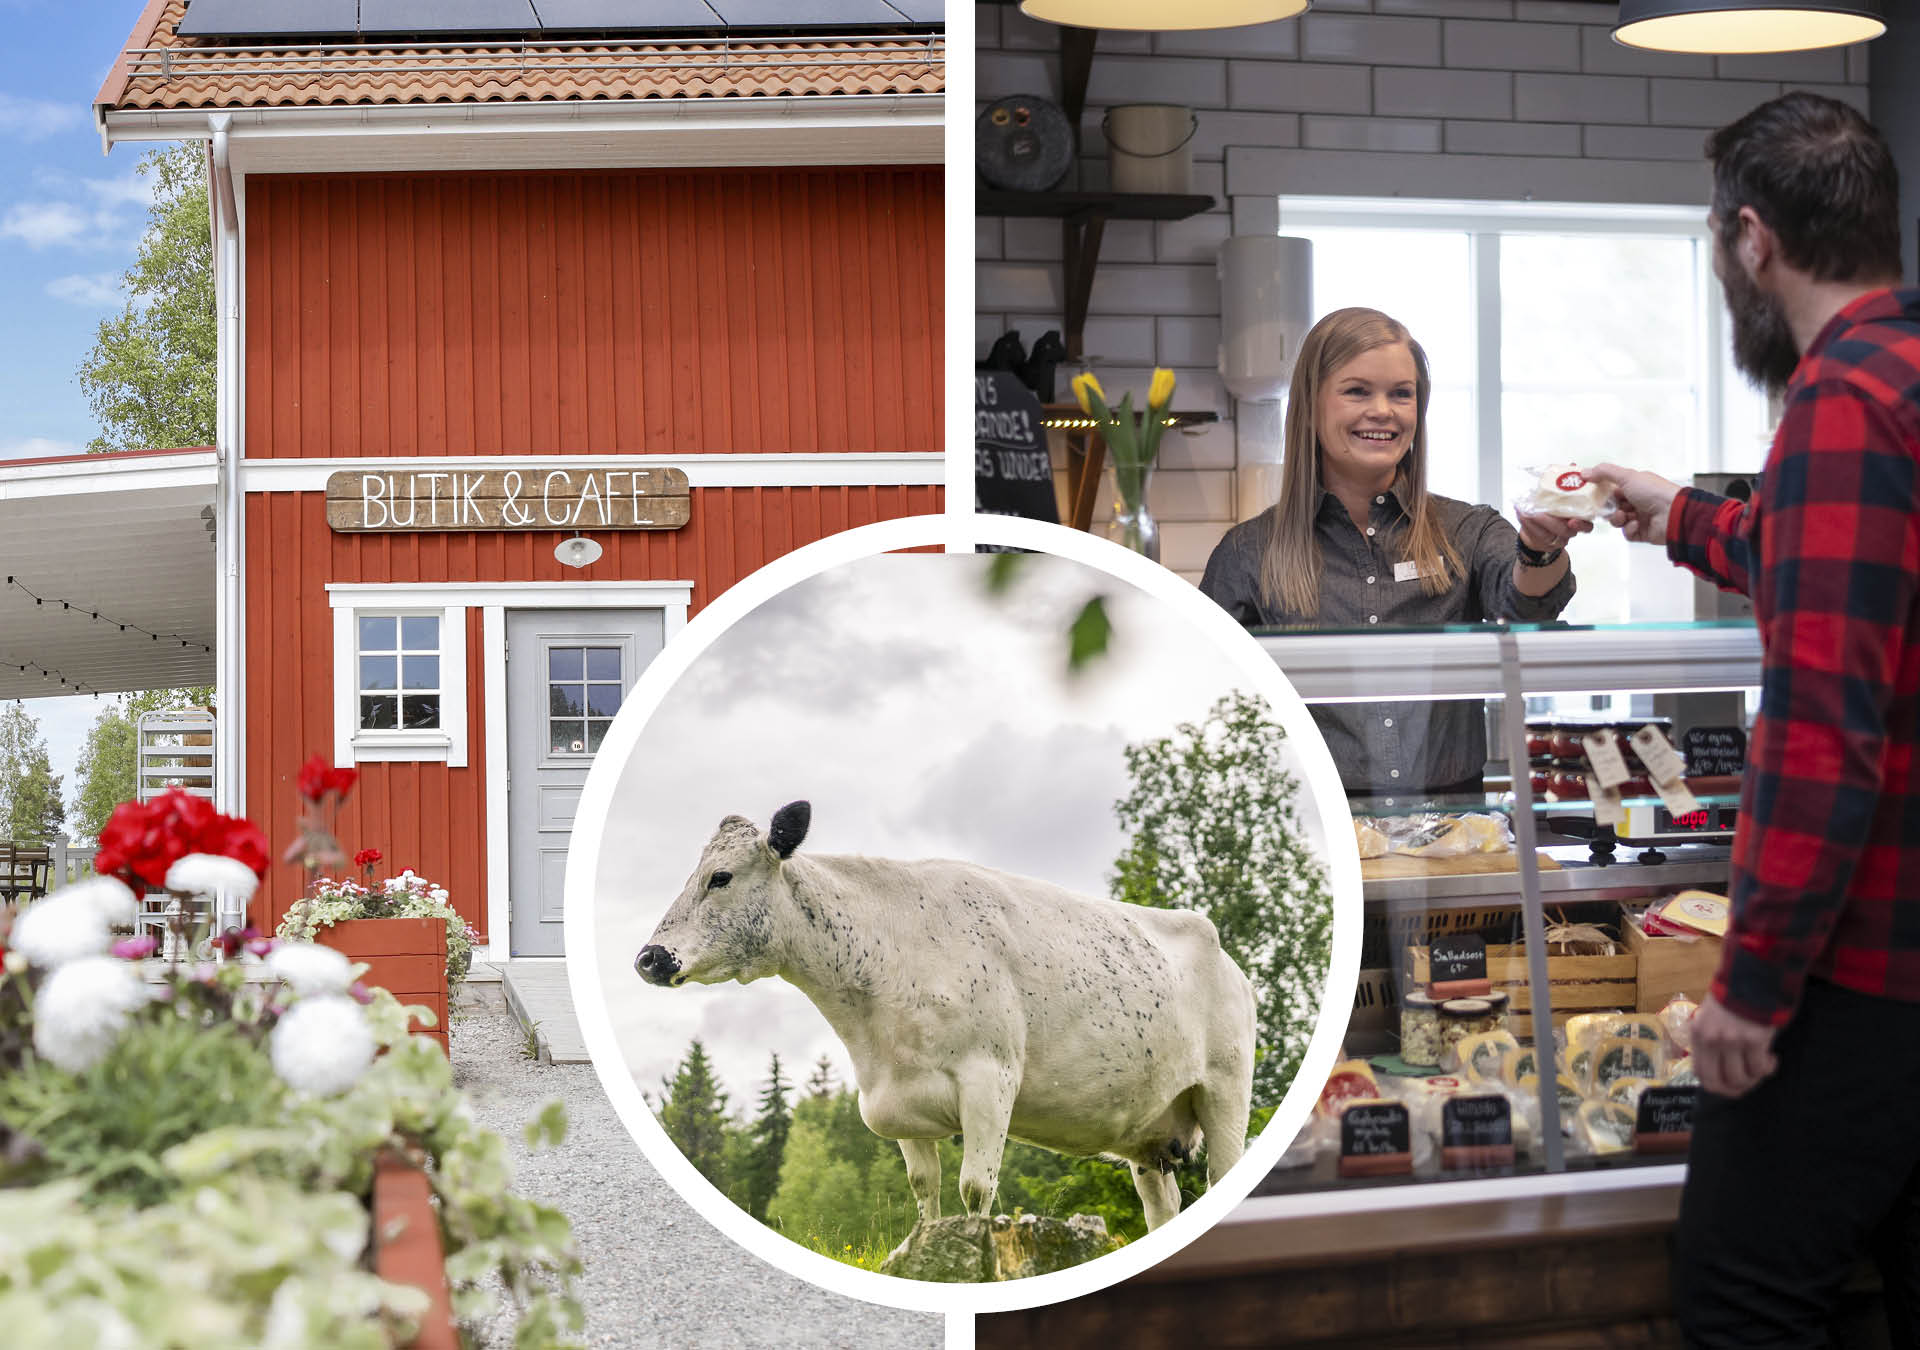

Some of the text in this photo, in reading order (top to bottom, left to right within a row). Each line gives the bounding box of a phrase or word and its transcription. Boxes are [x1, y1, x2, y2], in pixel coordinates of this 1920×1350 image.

[997, 451, 1051, 480] UNDER
[361, 470, 654, 529] BUTIK & CAFE
[1433, 948, 1484, 962] Salladsost
